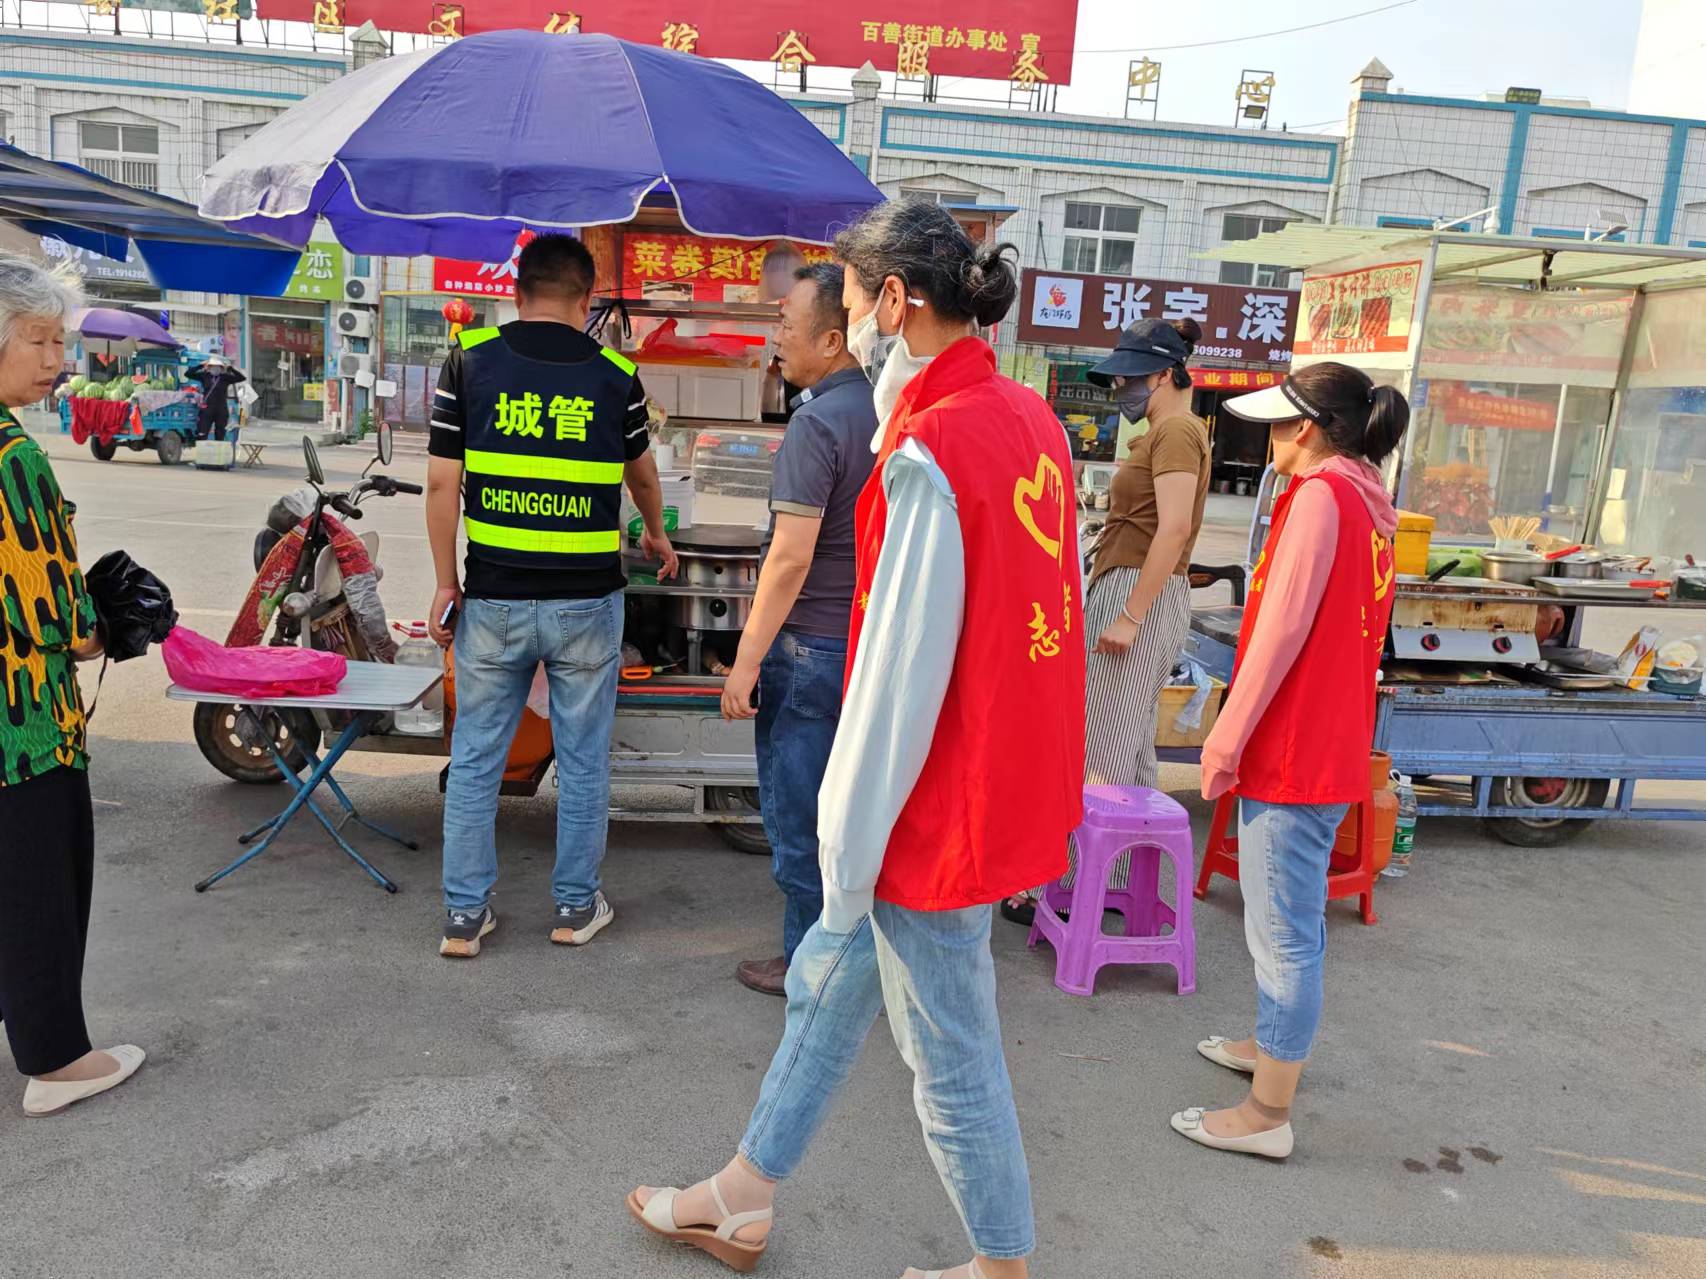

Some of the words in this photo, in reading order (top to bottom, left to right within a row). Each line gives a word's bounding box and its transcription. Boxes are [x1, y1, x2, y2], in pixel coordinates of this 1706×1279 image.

[861, 21, 1008, 52] 百善街道办事处
[1190, 371, 1288, 386] 业期间
[495, 391, 594, 442] 城管
[481, 487, 591, 518] CHENGGUAN
